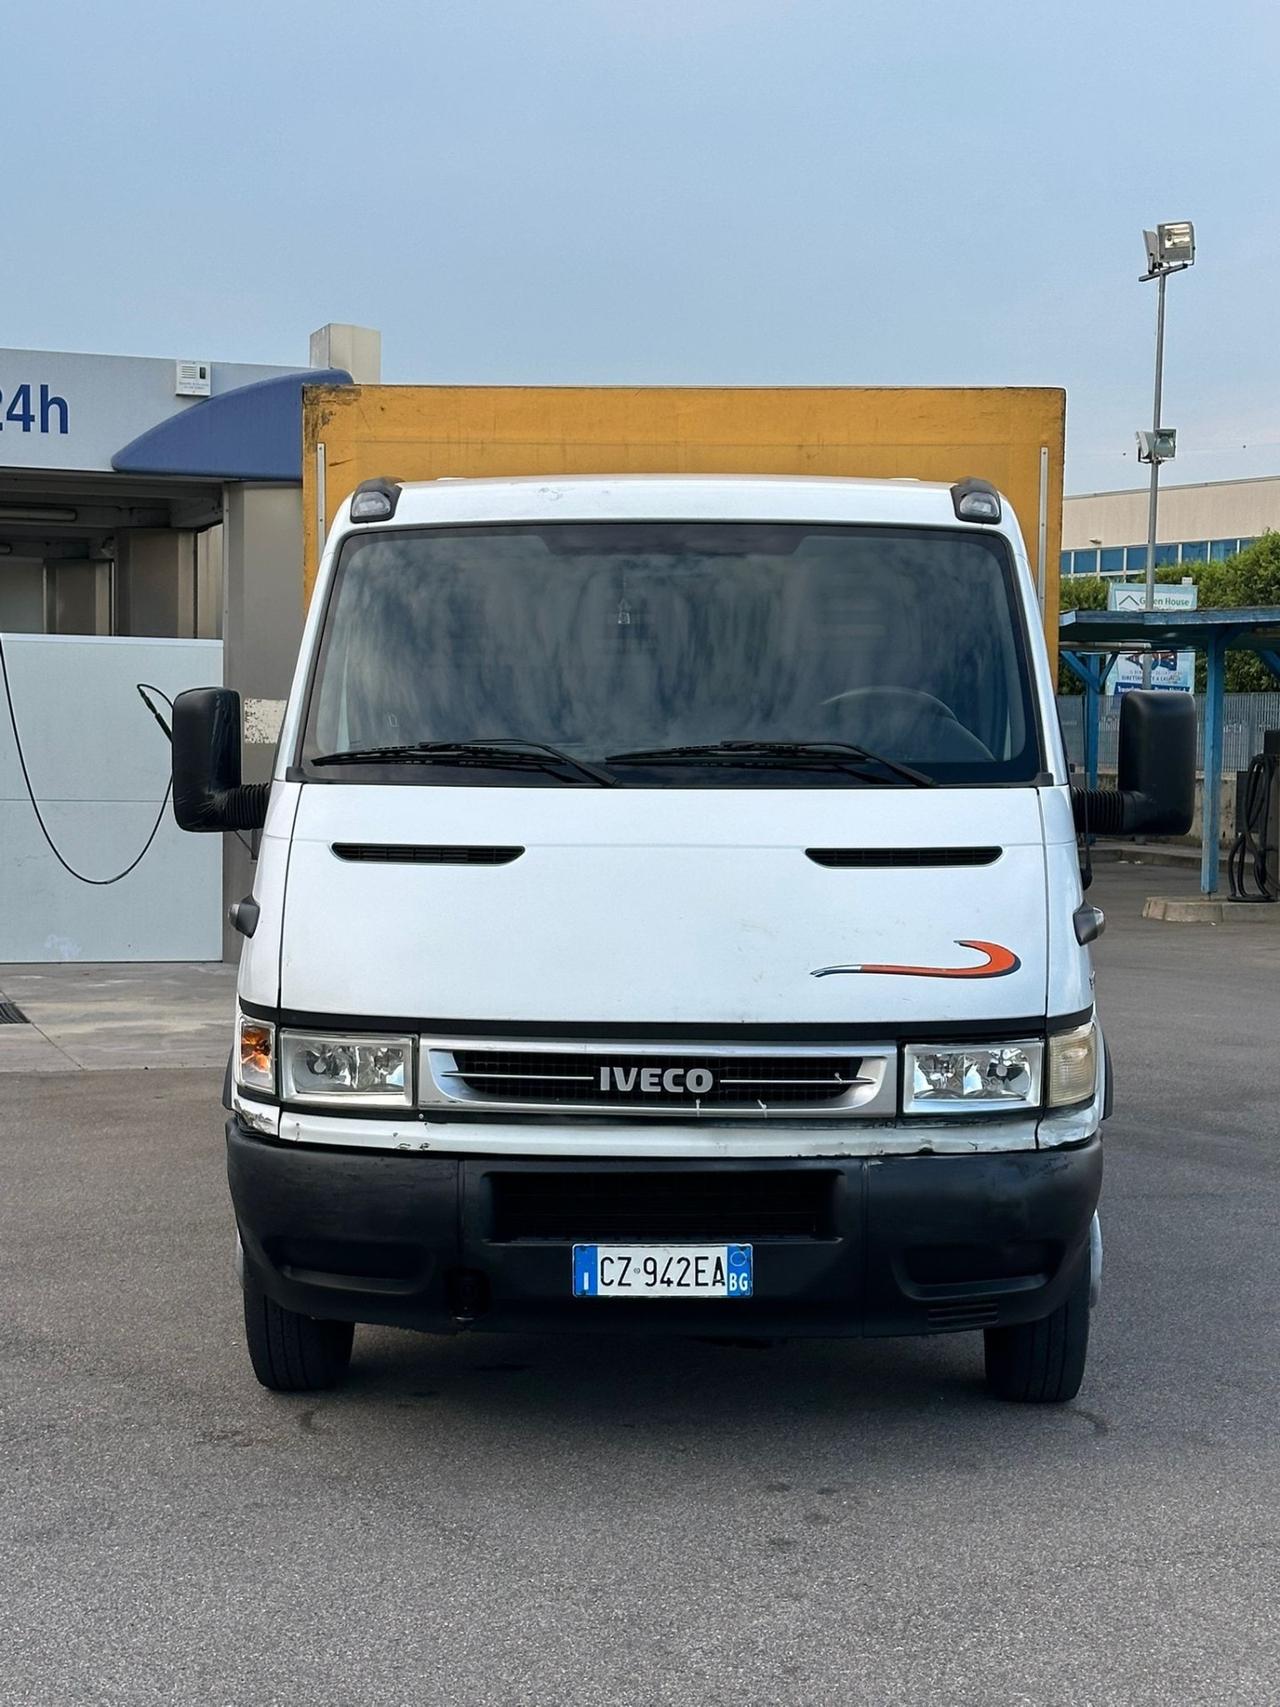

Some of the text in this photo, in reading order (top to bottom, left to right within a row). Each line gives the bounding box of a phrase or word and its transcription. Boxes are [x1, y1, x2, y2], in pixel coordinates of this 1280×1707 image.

[0, 384, 69, 434] 4h
[1139, 596, 1190, 607] Gen House
[600, 1066, 713, 1093] IVECO
[729, 1272, 749, 1291] BG
